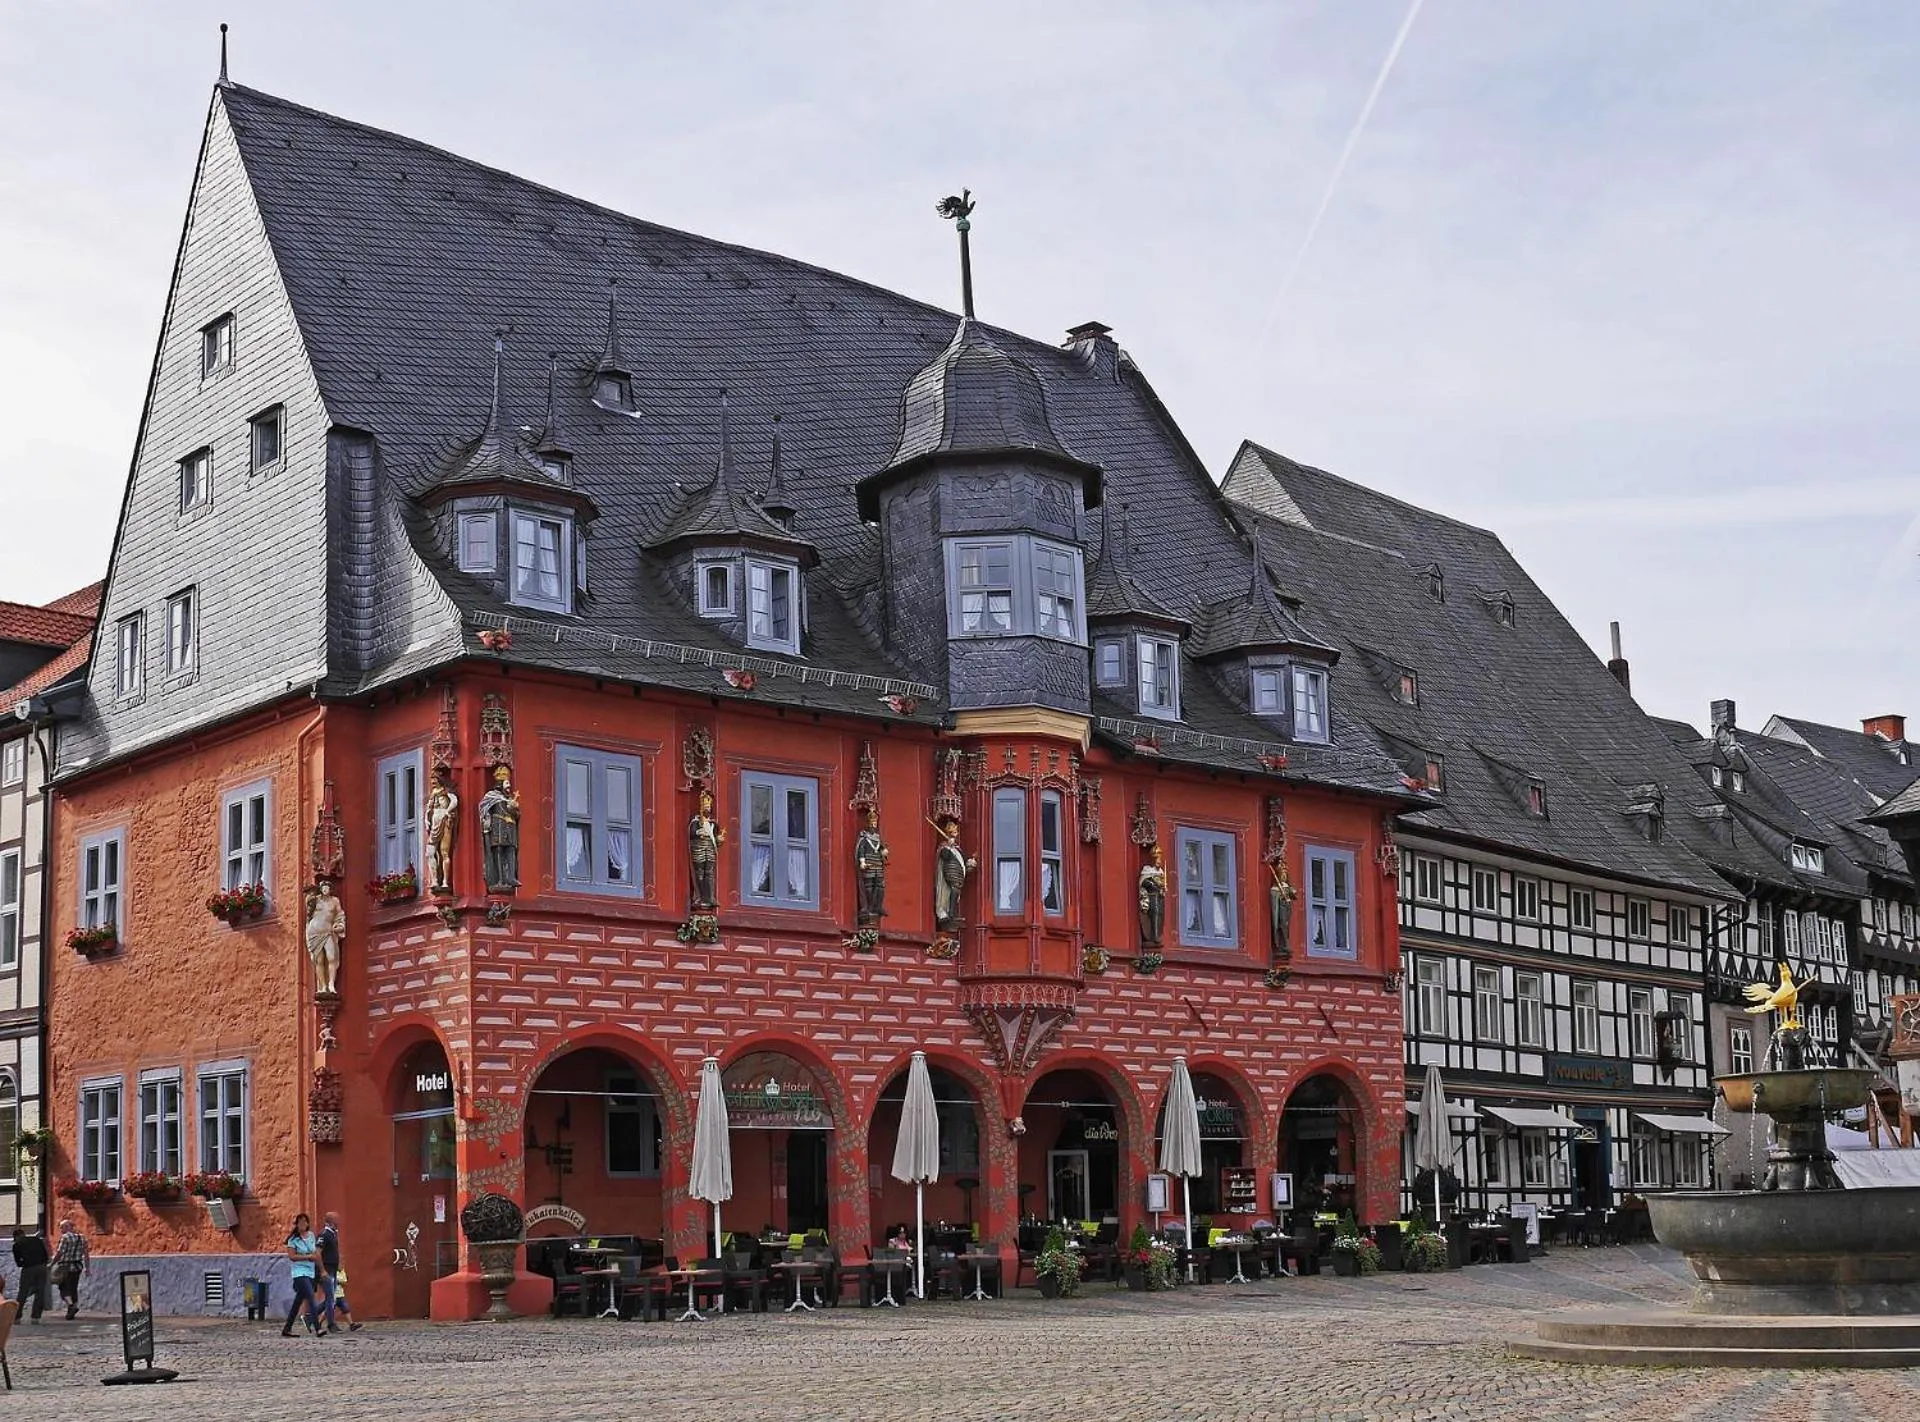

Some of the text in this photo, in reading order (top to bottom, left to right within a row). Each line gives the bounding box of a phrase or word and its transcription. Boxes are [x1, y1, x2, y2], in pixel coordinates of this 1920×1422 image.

[416, 1072, 448, 1092] Hotel
[783, 1082, 811, 1092] Hotel
[1208, 1099, 1229, 1108] Hotel
